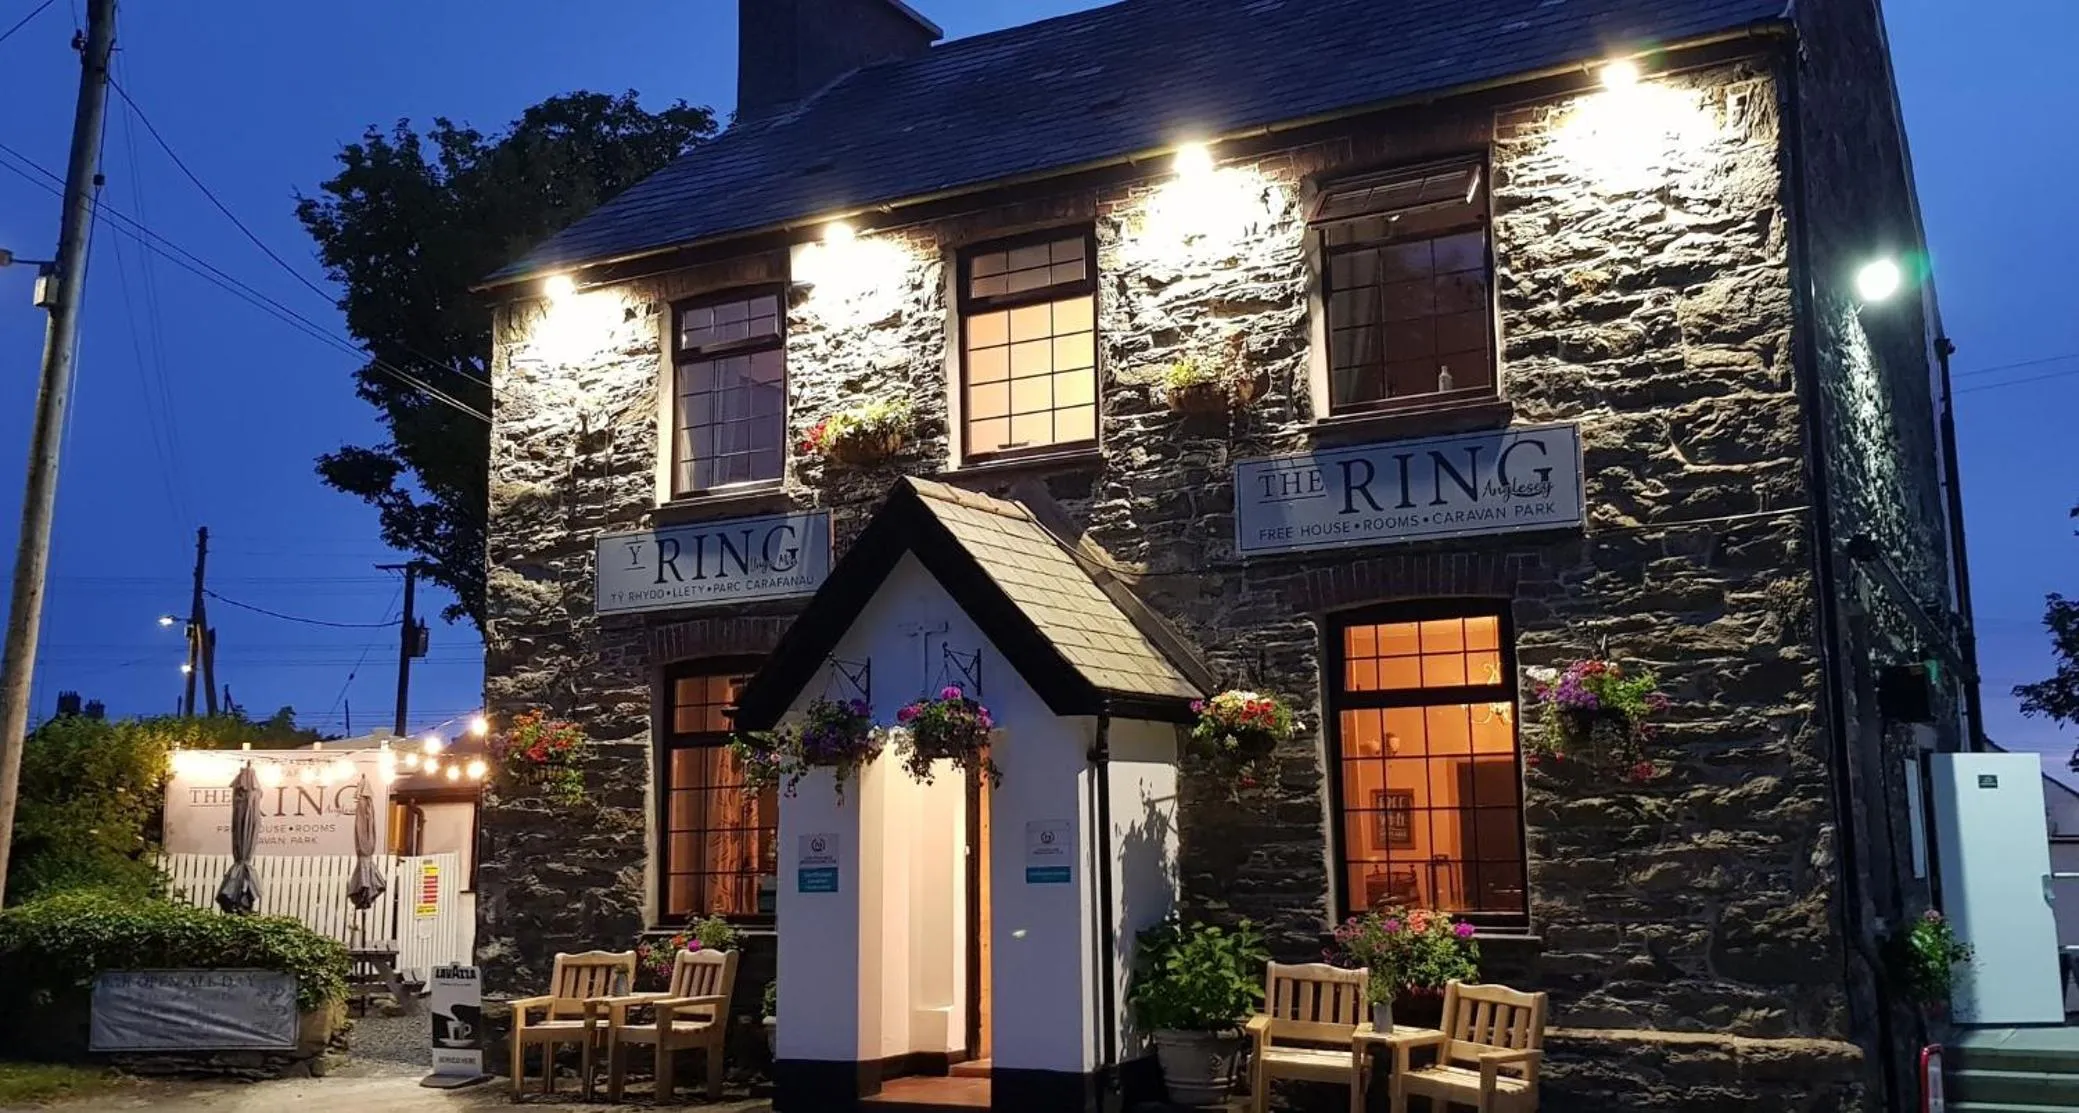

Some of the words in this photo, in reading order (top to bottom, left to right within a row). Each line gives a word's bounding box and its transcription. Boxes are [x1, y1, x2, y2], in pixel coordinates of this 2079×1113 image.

[1258, 469, 1326, 497] THE
[1337, 440, 1553, 515] RING
[1482, 477, 1554, 502] Anglesey
[1259, 526, 1293, 541] FREE
[1301, 521, 1350, 537] HOUSE
[1363, 514, 1420, 531] ROOMS
[1432, 507, 1507, 525] CARAVAN
[1514, 501, 1556, 518] PARK
[628, 546, 642, 565] Y
[654, 525, 799, 585] RING
[628, 588, 665, 601] RHYDD
[672, 584, 705, 598] LLETY
[713, 581, 741, 593] PARC
[746, 575, 815, 590] CARAFANAU
[189, 789, 231, 804] THE
[259, 825, 285, 833] OUSE
[295, 824, 336, 833] ROOMS
[290, 836, 319, 845] PARK
[436, 966, 477, 980] LAVAZZA
